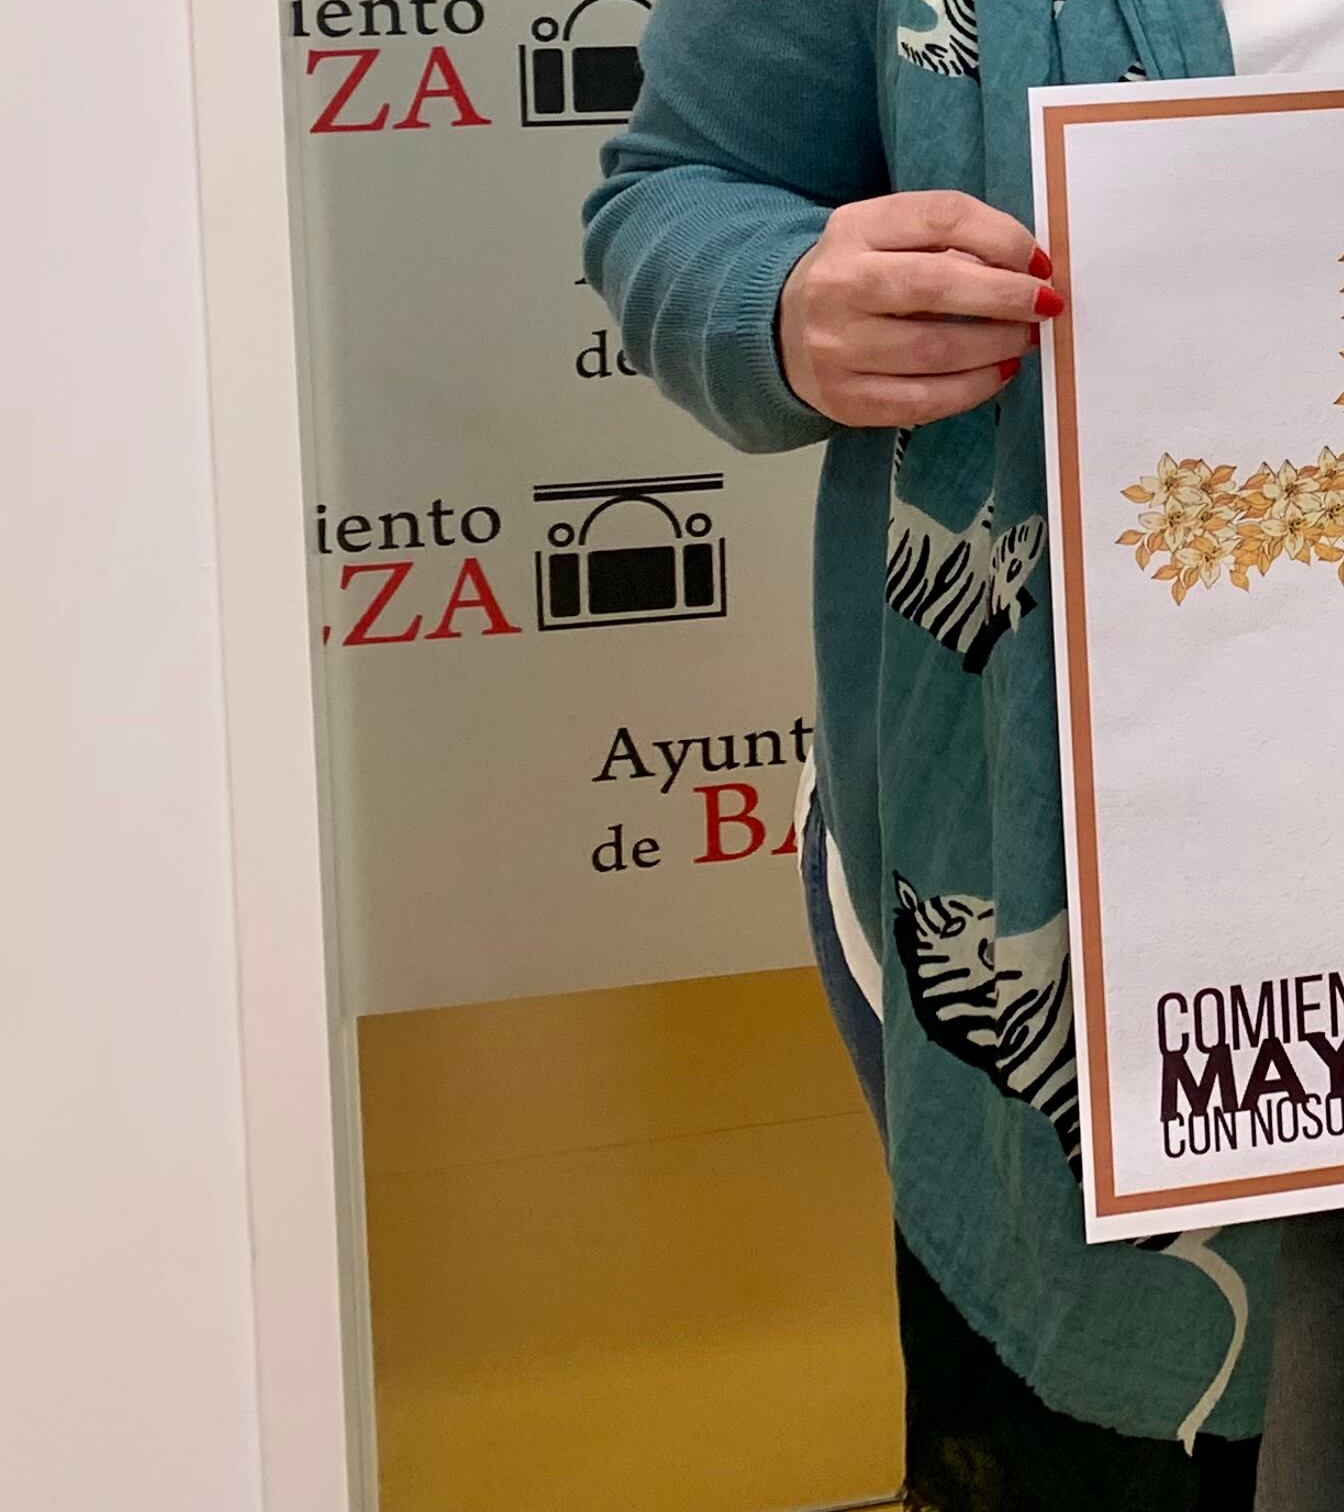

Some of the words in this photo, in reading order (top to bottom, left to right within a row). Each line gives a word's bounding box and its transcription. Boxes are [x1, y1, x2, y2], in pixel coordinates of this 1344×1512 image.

[322, 556, 523, 647] ZA
[592, 824, 661, 873] de
[1163, 1105, 1238, 1158] CON
